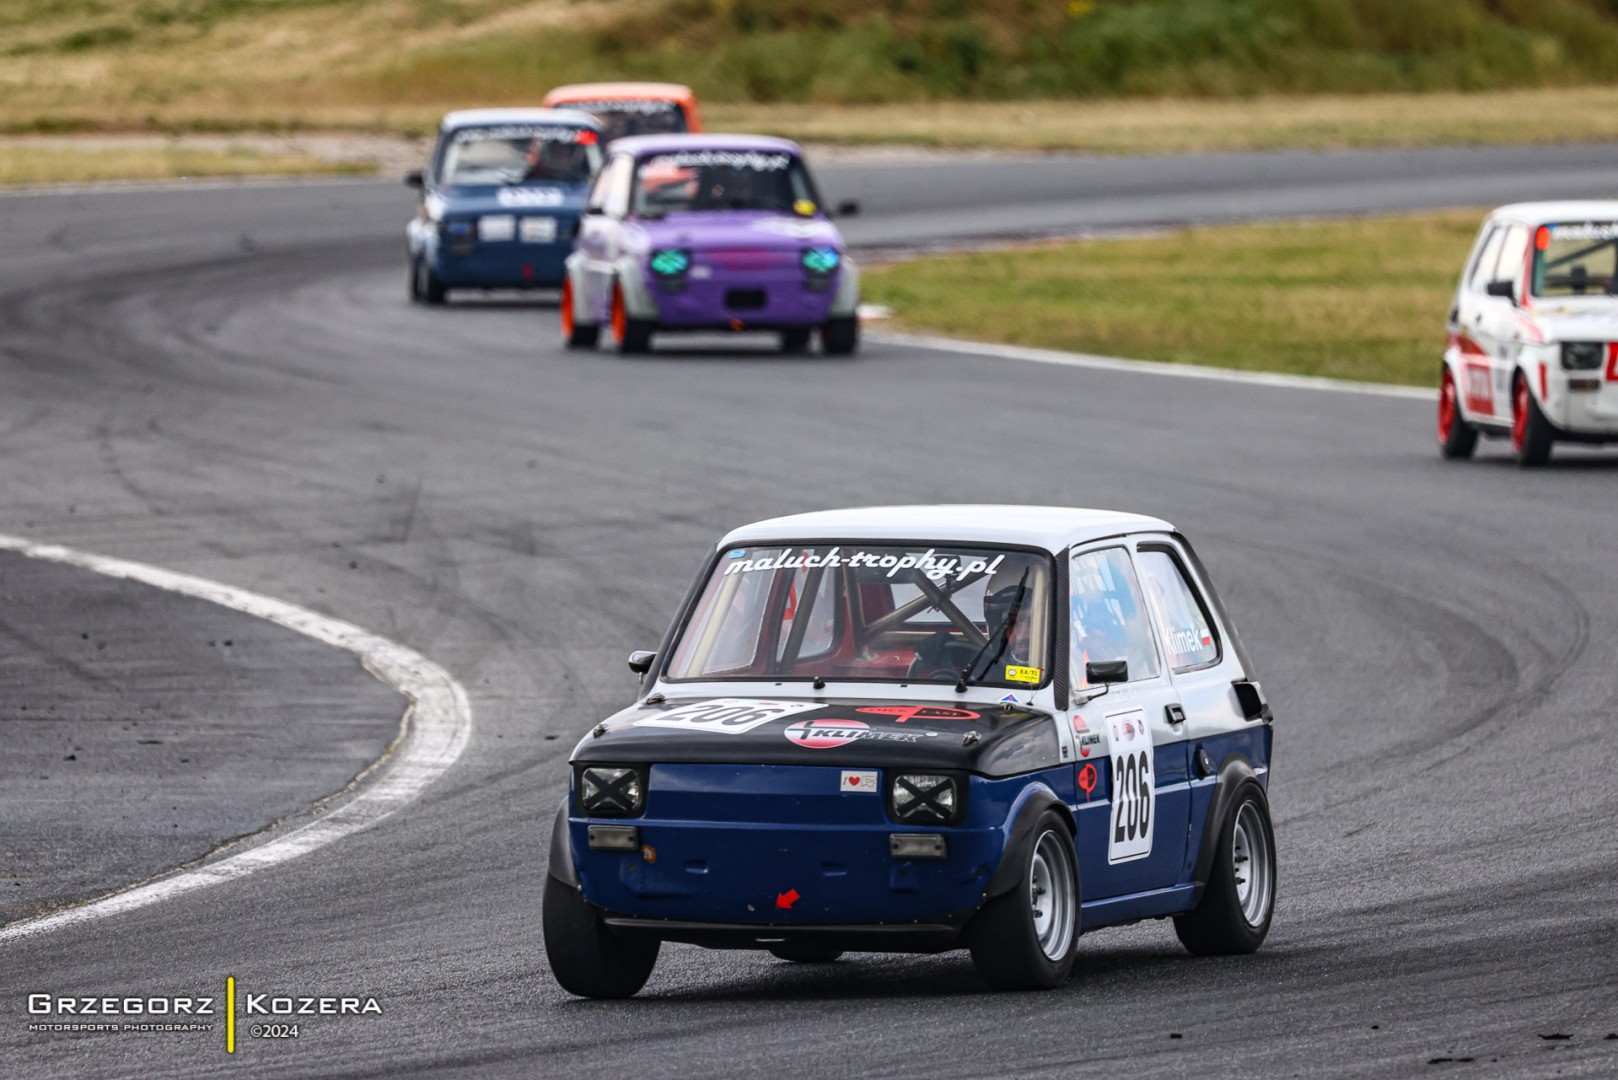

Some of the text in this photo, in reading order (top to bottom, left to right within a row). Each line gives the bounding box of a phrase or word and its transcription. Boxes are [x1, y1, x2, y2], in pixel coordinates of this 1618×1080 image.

[724, 547, 1005, 581] maluch-trophy.pl
[656, 704, 785, 725] 206
[812, 729, 924, 742] KLIMEK
[1114, 751, 1150, 843] 206
